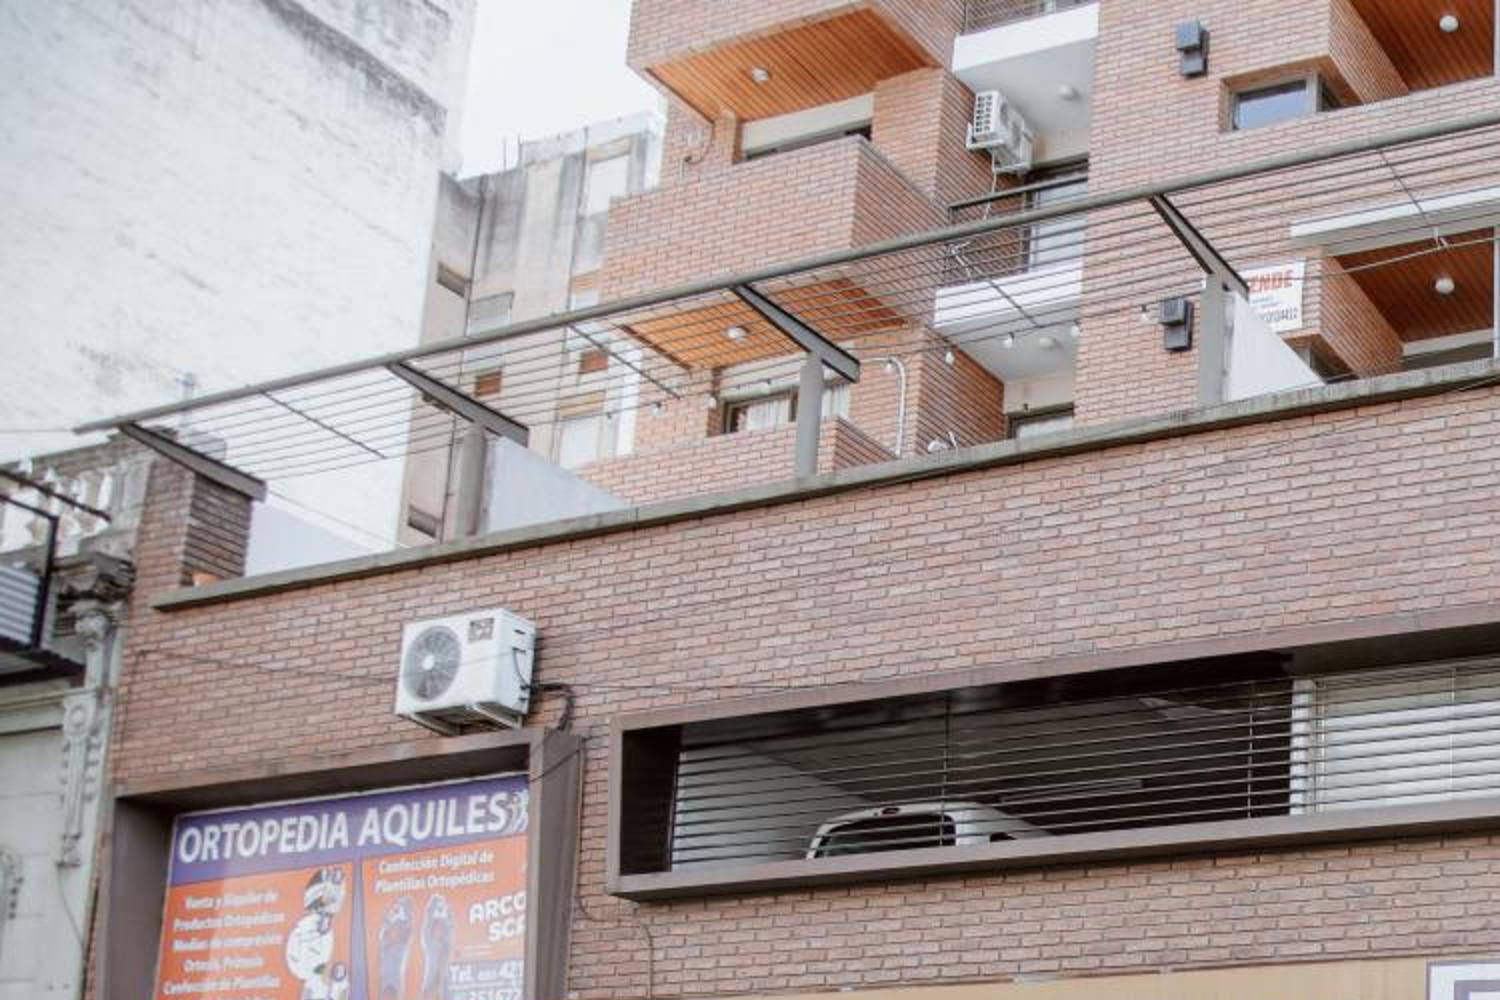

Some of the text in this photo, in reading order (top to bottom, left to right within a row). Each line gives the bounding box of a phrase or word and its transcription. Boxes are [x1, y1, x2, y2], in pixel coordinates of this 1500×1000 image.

[1247, 270, 1293, 293] ENDE
[179, 792, 507, 863] ORTOPEDIA AQUILES
[469, 891, 526, 924] ARCO
